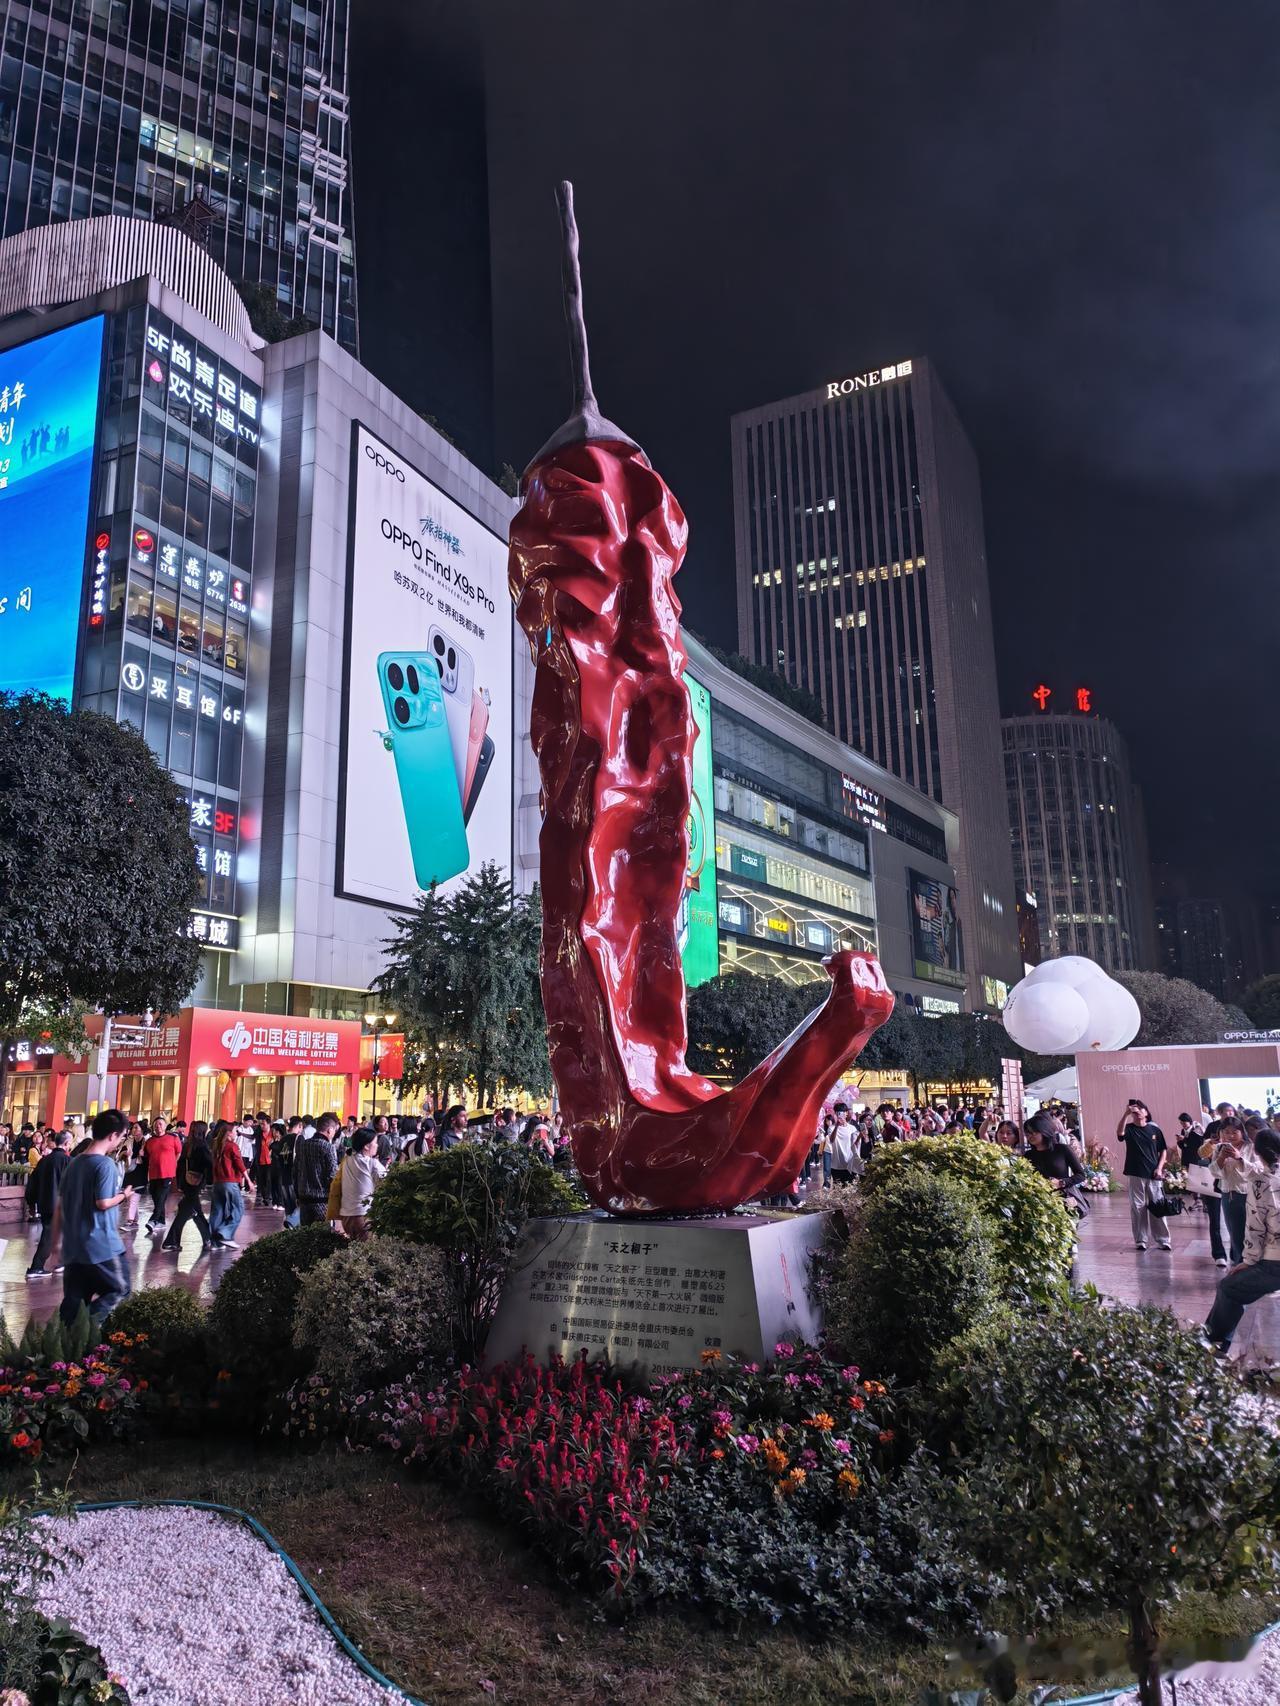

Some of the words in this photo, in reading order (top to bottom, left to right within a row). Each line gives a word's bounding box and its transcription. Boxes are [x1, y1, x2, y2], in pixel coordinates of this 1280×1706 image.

[381, 518, 423, 561] OPPO
[425, 548, 451, 583] Find
[454, 568, 475, 600] X9s
[477, 586, 495, 614] Pro
[253, 1027, 339, 1050] 中国福利彩票
[1224, 1032, 1248, 1040] OPPO
[1249, 1031, 1267, 1039] Find
[116, 1049, 146, 1058] WELFARE
[149, 1048, 178, 1057] LOTTERY
[252, 1047, 275, 1056] CHINA
[278, 1048, 308, 1057] WELFARE
[311, 1050, 338, 1059] LOTTERY
[1102, 1064, 1124, 1072] OPPO
[1125, 1064, 1140, 1072] Find
